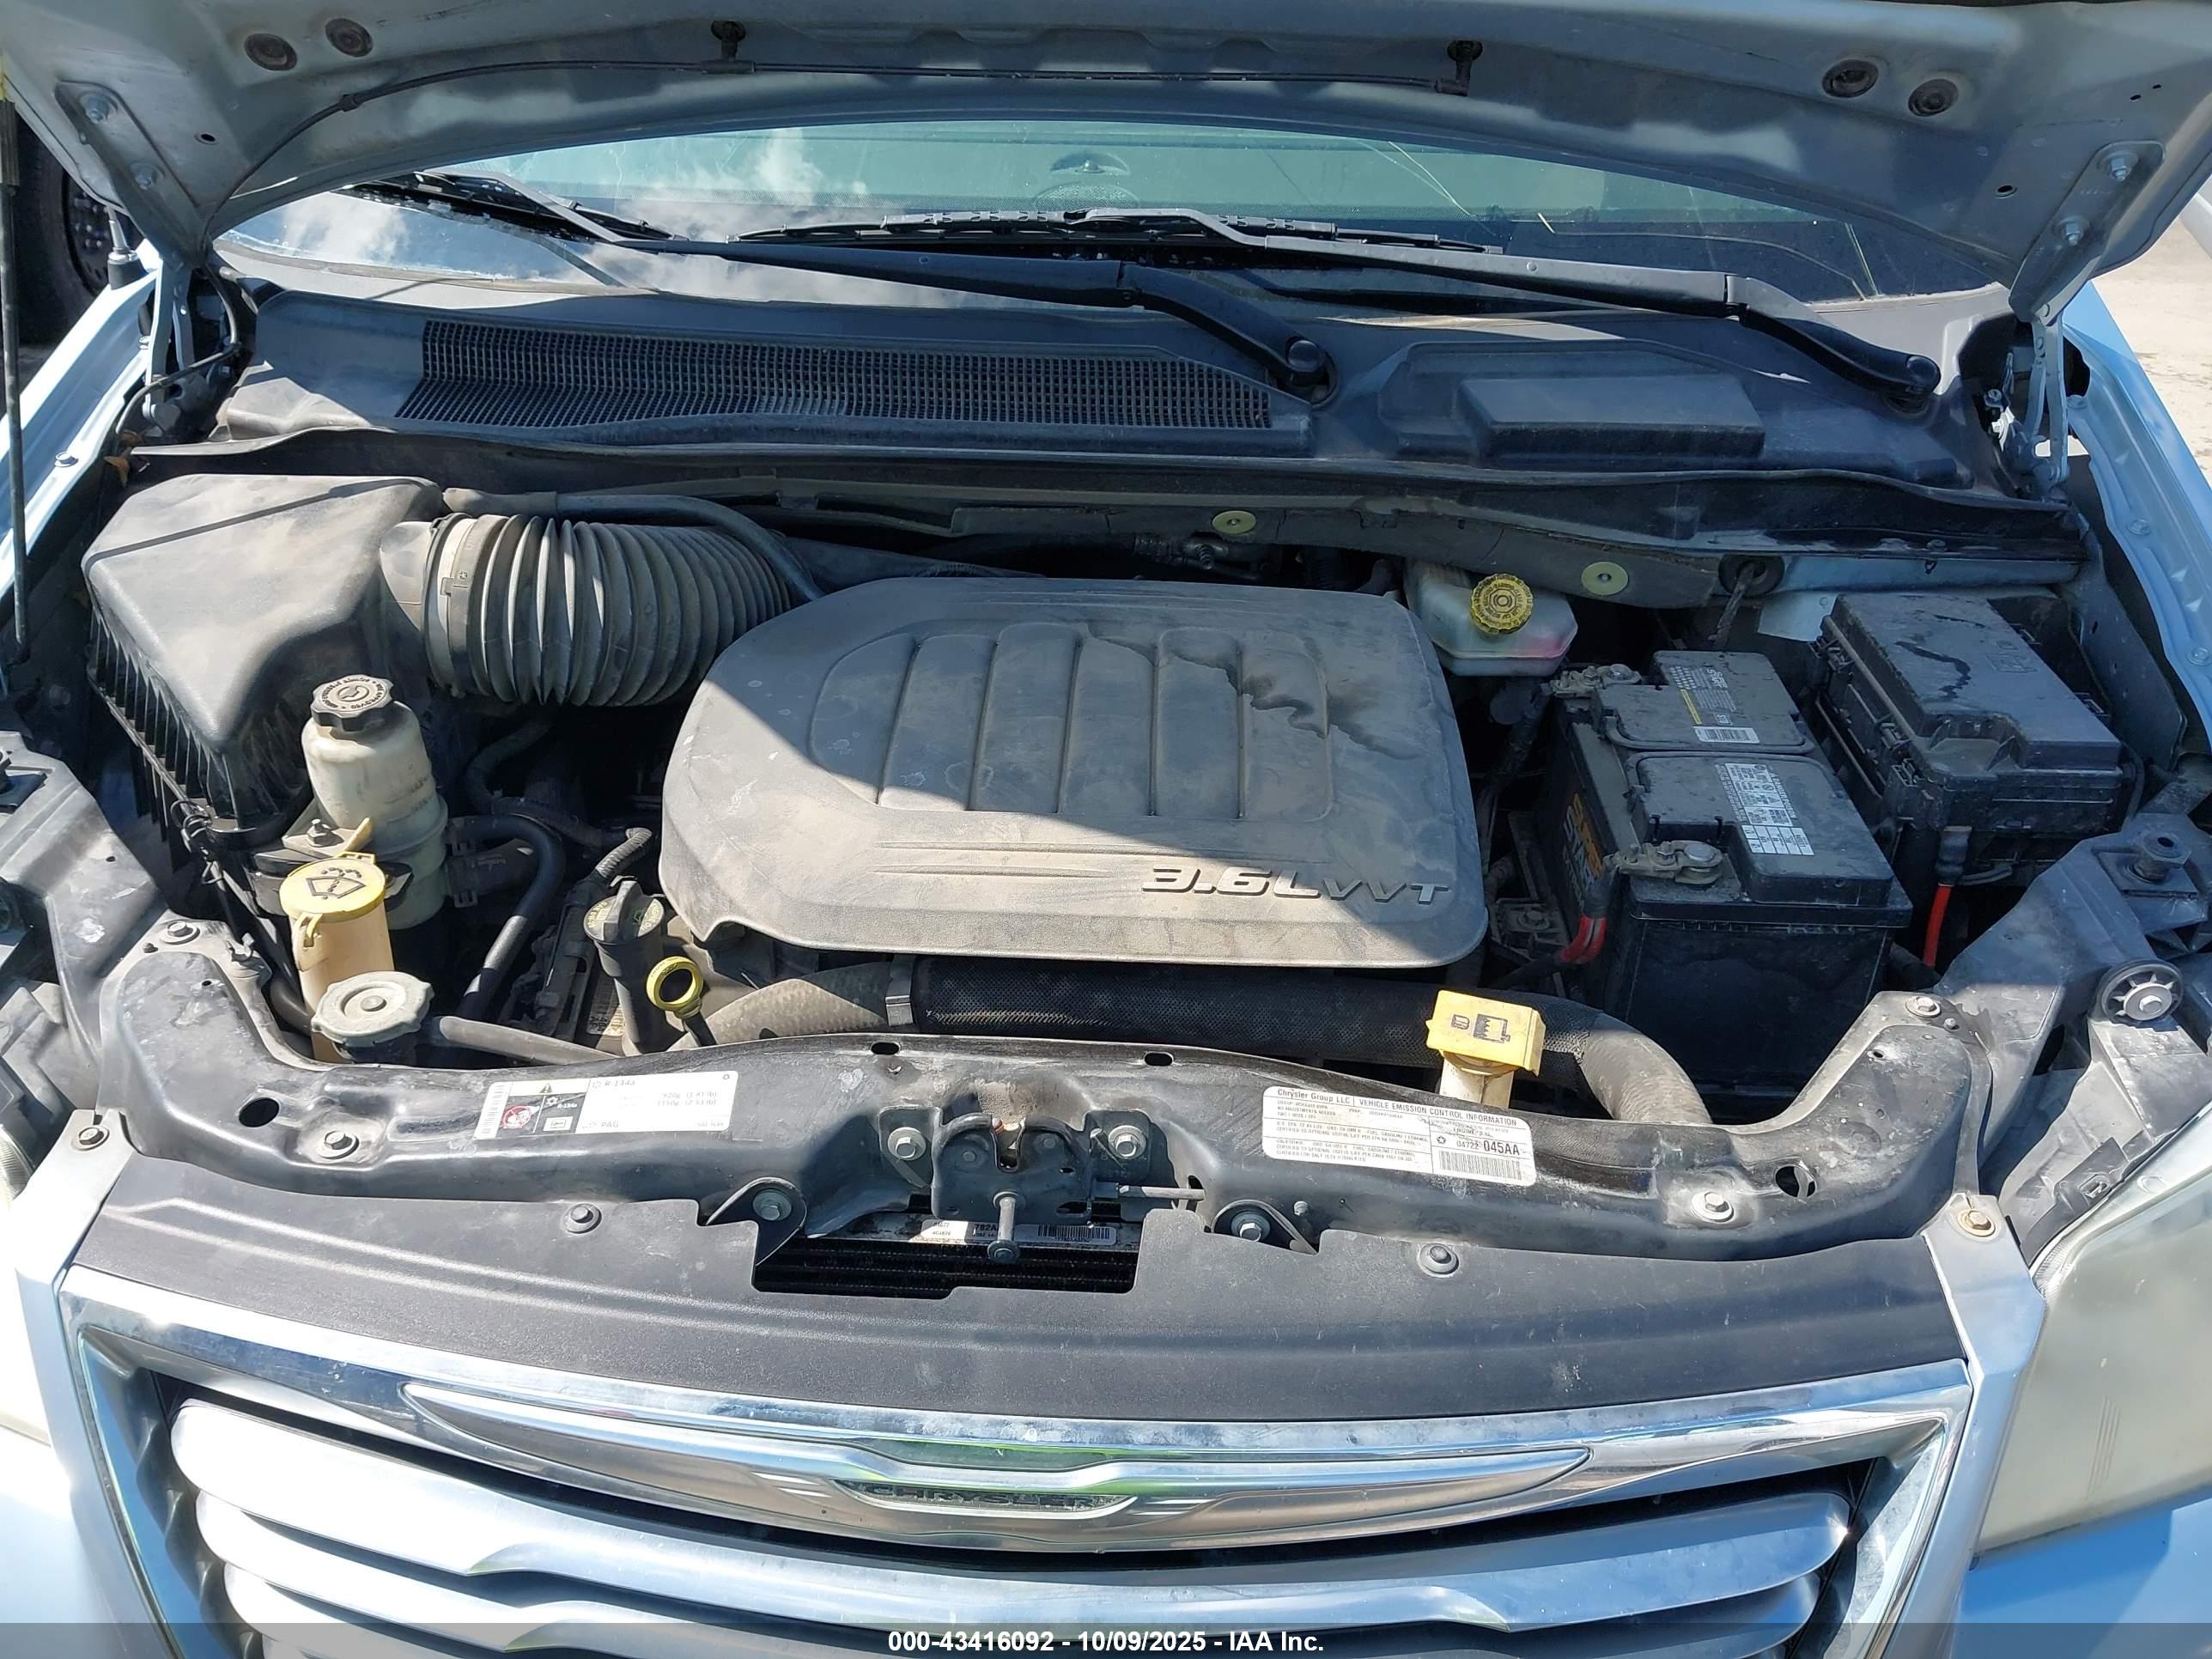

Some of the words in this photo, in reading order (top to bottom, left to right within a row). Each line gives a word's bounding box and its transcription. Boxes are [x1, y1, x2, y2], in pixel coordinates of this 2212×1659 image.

[1142, 866, 1322, 899] 3.6L
[1322, 878, 1449, 905] VVT
[1278, 1089, 1308, 1099] Chrysler
[1311, 1093, 1333, 1103] Group
[1359, 1099, 1389, 1109] VEHICLE
[1392, 1103, 1427, 1115] EMISSION
[1430, 1109, 1463, 1120] CONTROL
[1466, 1114, 1516, 1126] INFORMATION
[1483, 1140, 1520, 1155] 045AA
